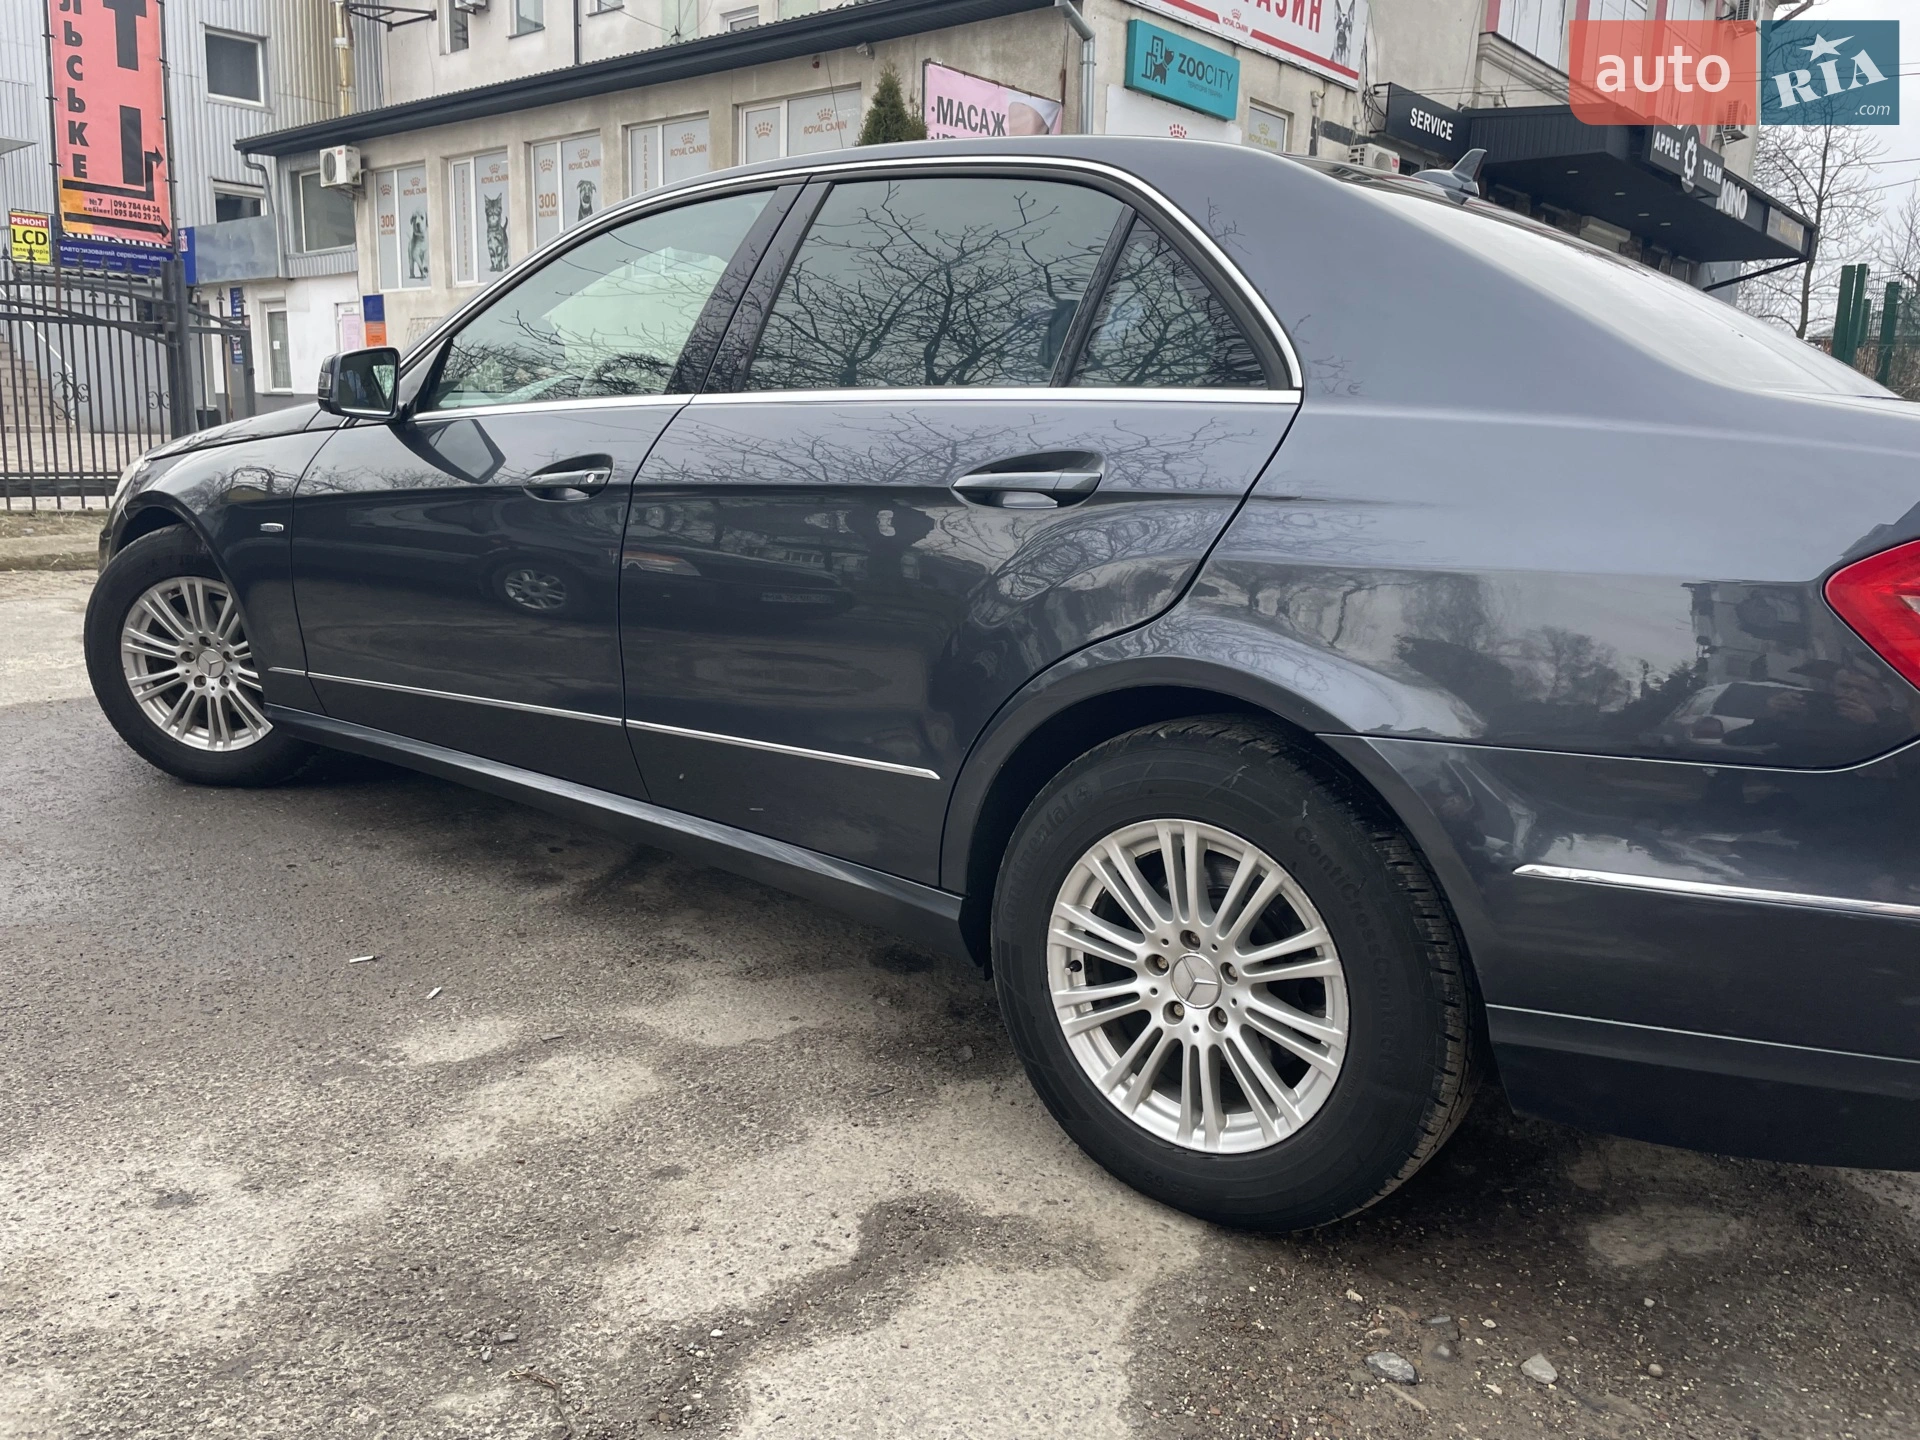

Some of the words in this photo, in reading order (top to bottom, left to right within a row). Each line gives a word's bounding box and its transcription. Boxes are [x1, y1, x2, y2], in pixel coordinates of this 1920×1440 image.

[803, 124, 824, 135] ROYAL
[825, 120, 848, 131] CANIN
[1410, 107, 1454, 141] SERVICE
[670, 147, 688, 156] ROYAL
[688, 143, 707, 154] CANIN
[1653, 131, 1681, 161] APPLE
[1703, 158, 1723, 185] TEAM
[113, 200, 127, 209] 096
[128, 202, 141, 211] 784
[142, 204, 151, 212] 64
[539, 192, 557, 209] 300
[1719, 178, 1748, 220] KINO
[11, 216, 47, 227] РЕМОНТ
[113, 208, 127, 217] 095
[128, 210, 141, 219] 840
[152, 214, 161, 222] 20
[380, 214, 395, 228] 300
[12, 228, 48, 246] LCD
